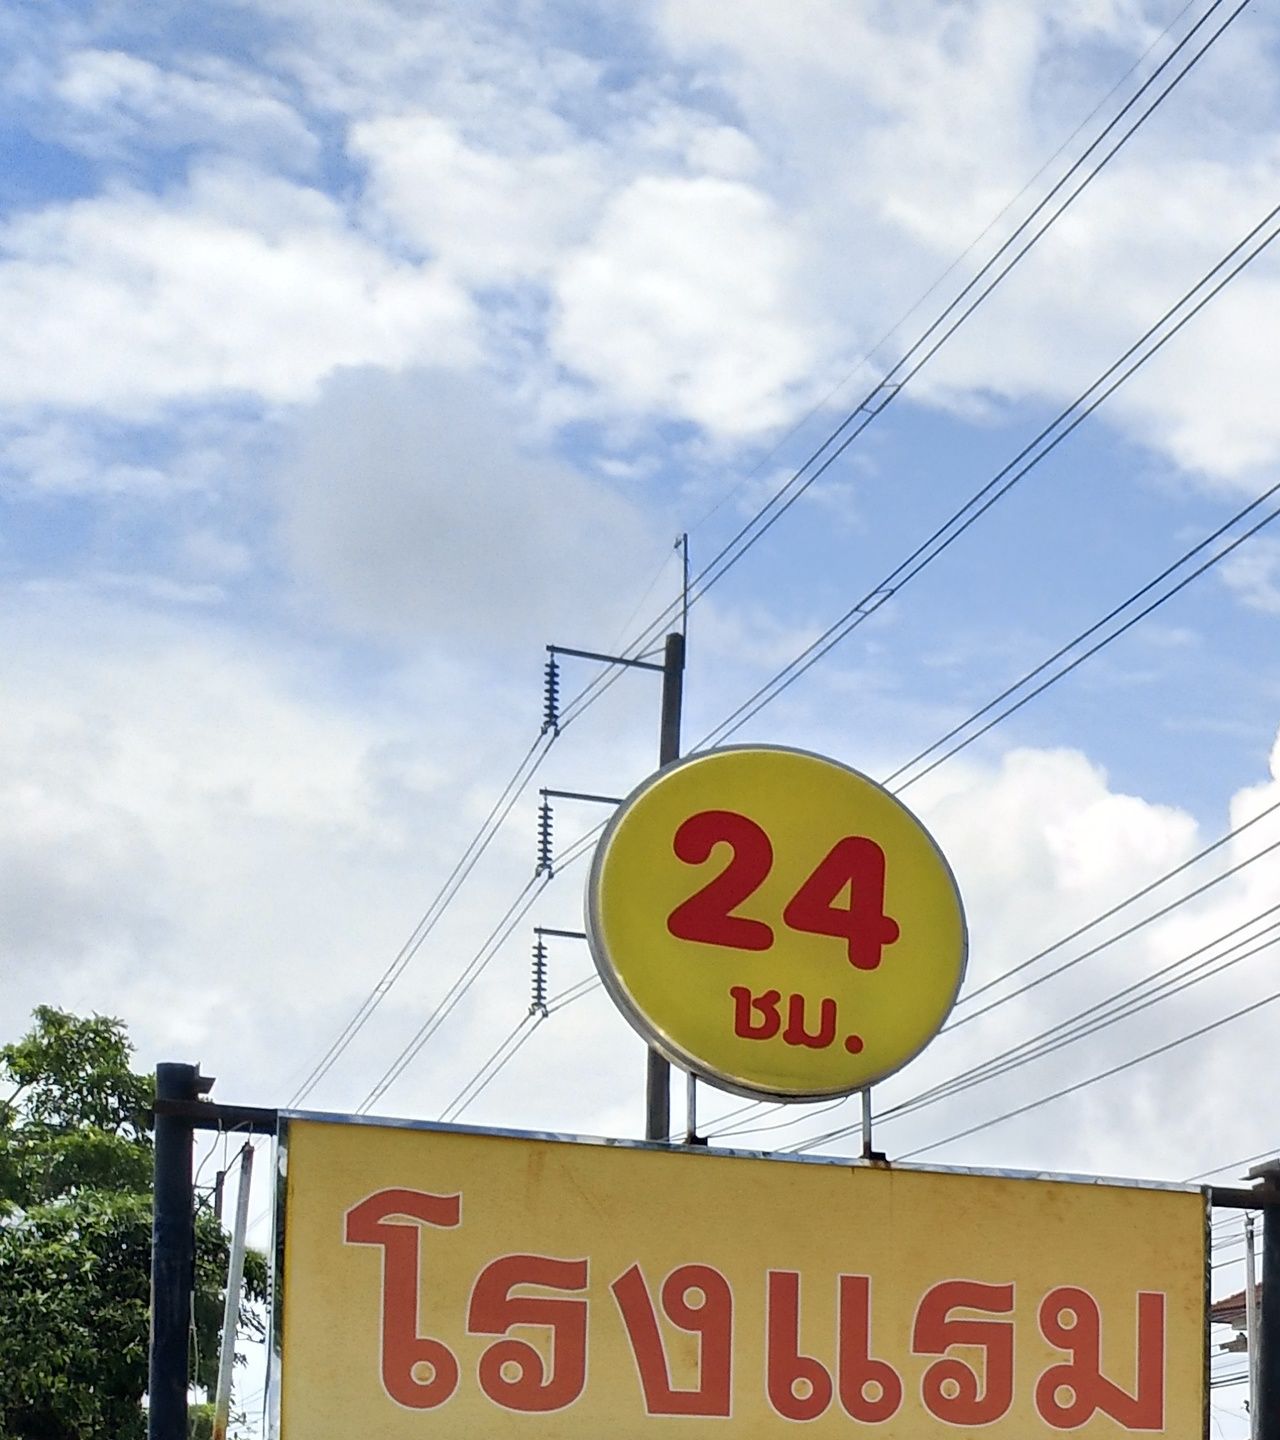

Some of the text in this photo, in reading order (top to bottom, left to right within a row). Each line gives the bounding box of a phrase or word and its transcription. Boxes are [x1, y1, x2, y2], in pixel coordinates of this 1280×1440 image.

[667, 810, 900, 970] 24
[730, 985, 865, 1054] ชม.
[345, 1188, 1166, 1431] โรงแรม
